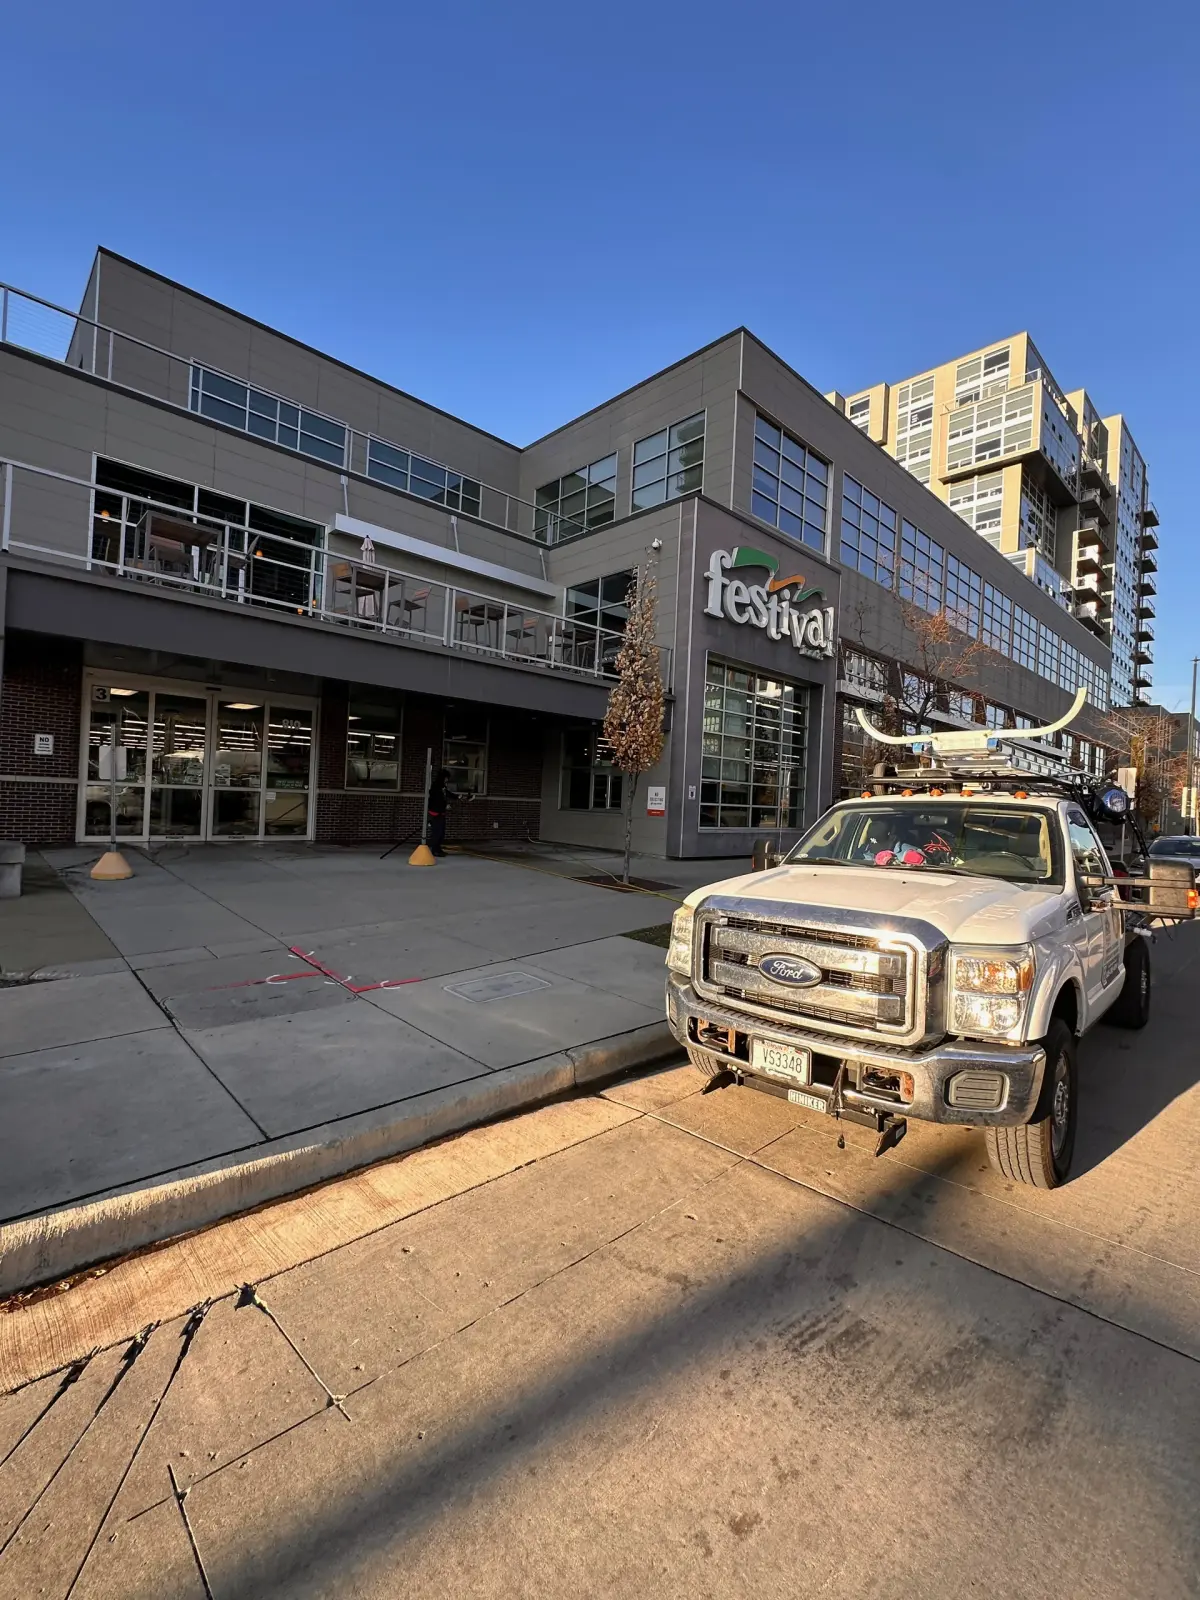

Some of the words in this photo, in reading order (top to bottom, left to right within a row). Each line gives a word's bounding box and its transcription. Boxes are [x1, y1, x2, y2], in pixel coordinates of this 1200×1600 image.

[703, 549, 835, 657] festival
[95, 687, 107, 700] 3
[770, 960, 804, 979] Ford
[763, 1047, 803, 1074] VS3348
[790, 1091, 825, 1111] HINIKER
